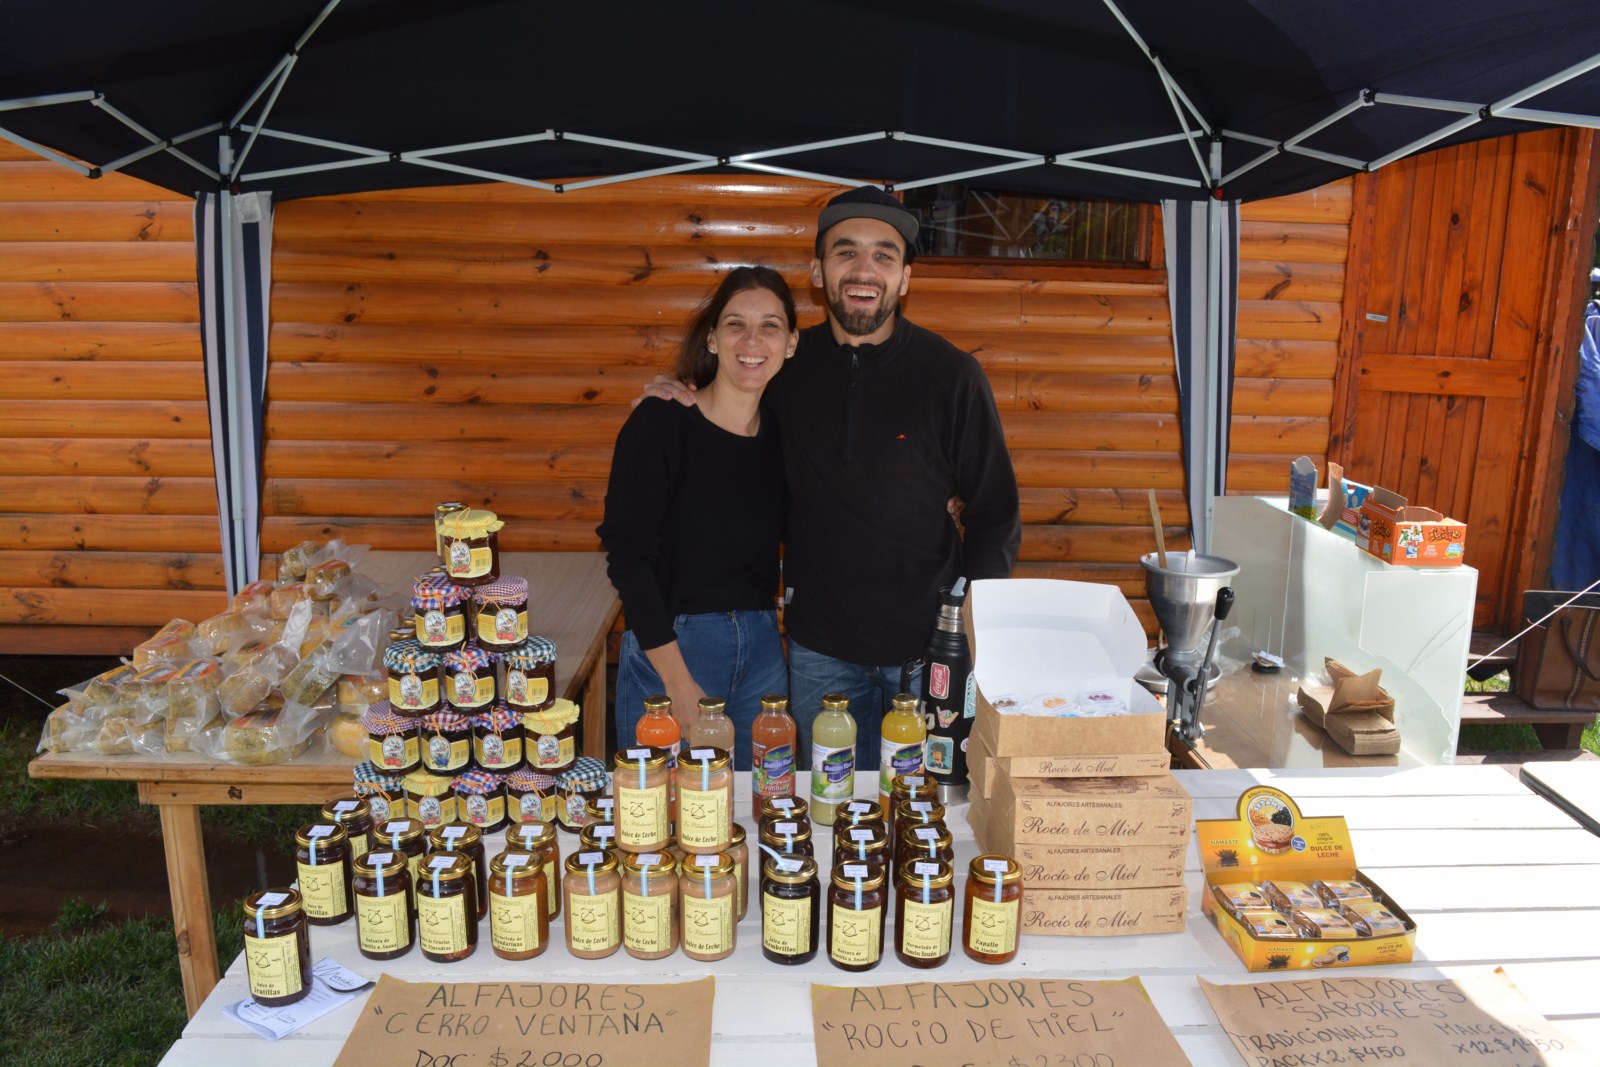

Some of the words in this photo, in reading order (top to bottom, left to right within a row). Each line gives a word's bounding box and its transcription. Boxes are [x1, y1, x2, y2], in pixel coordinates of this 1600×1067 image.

[1072, 762, 1082, 773] de
[1086, 761, 1117, 773] Miel
[1073, 820, 1090, 836] de
[1095, 819, 1143, 837] Miel
[1073, 866, 1091, 882] de
[1096, 864, 1142, 881] Miel
[1075, 911, 1091, 928] de
[1096, 911, 1142, 928] Miel
[975, 938, 999, 948] Zapallo
[426, 984, 645, 1011] ALFAJORES
[850, 981, 1095, 1012] ALFAJORES
[1253, 979, 1466, 1009] ALFAJORES
[965, 1017, 1016, 1044] DE
